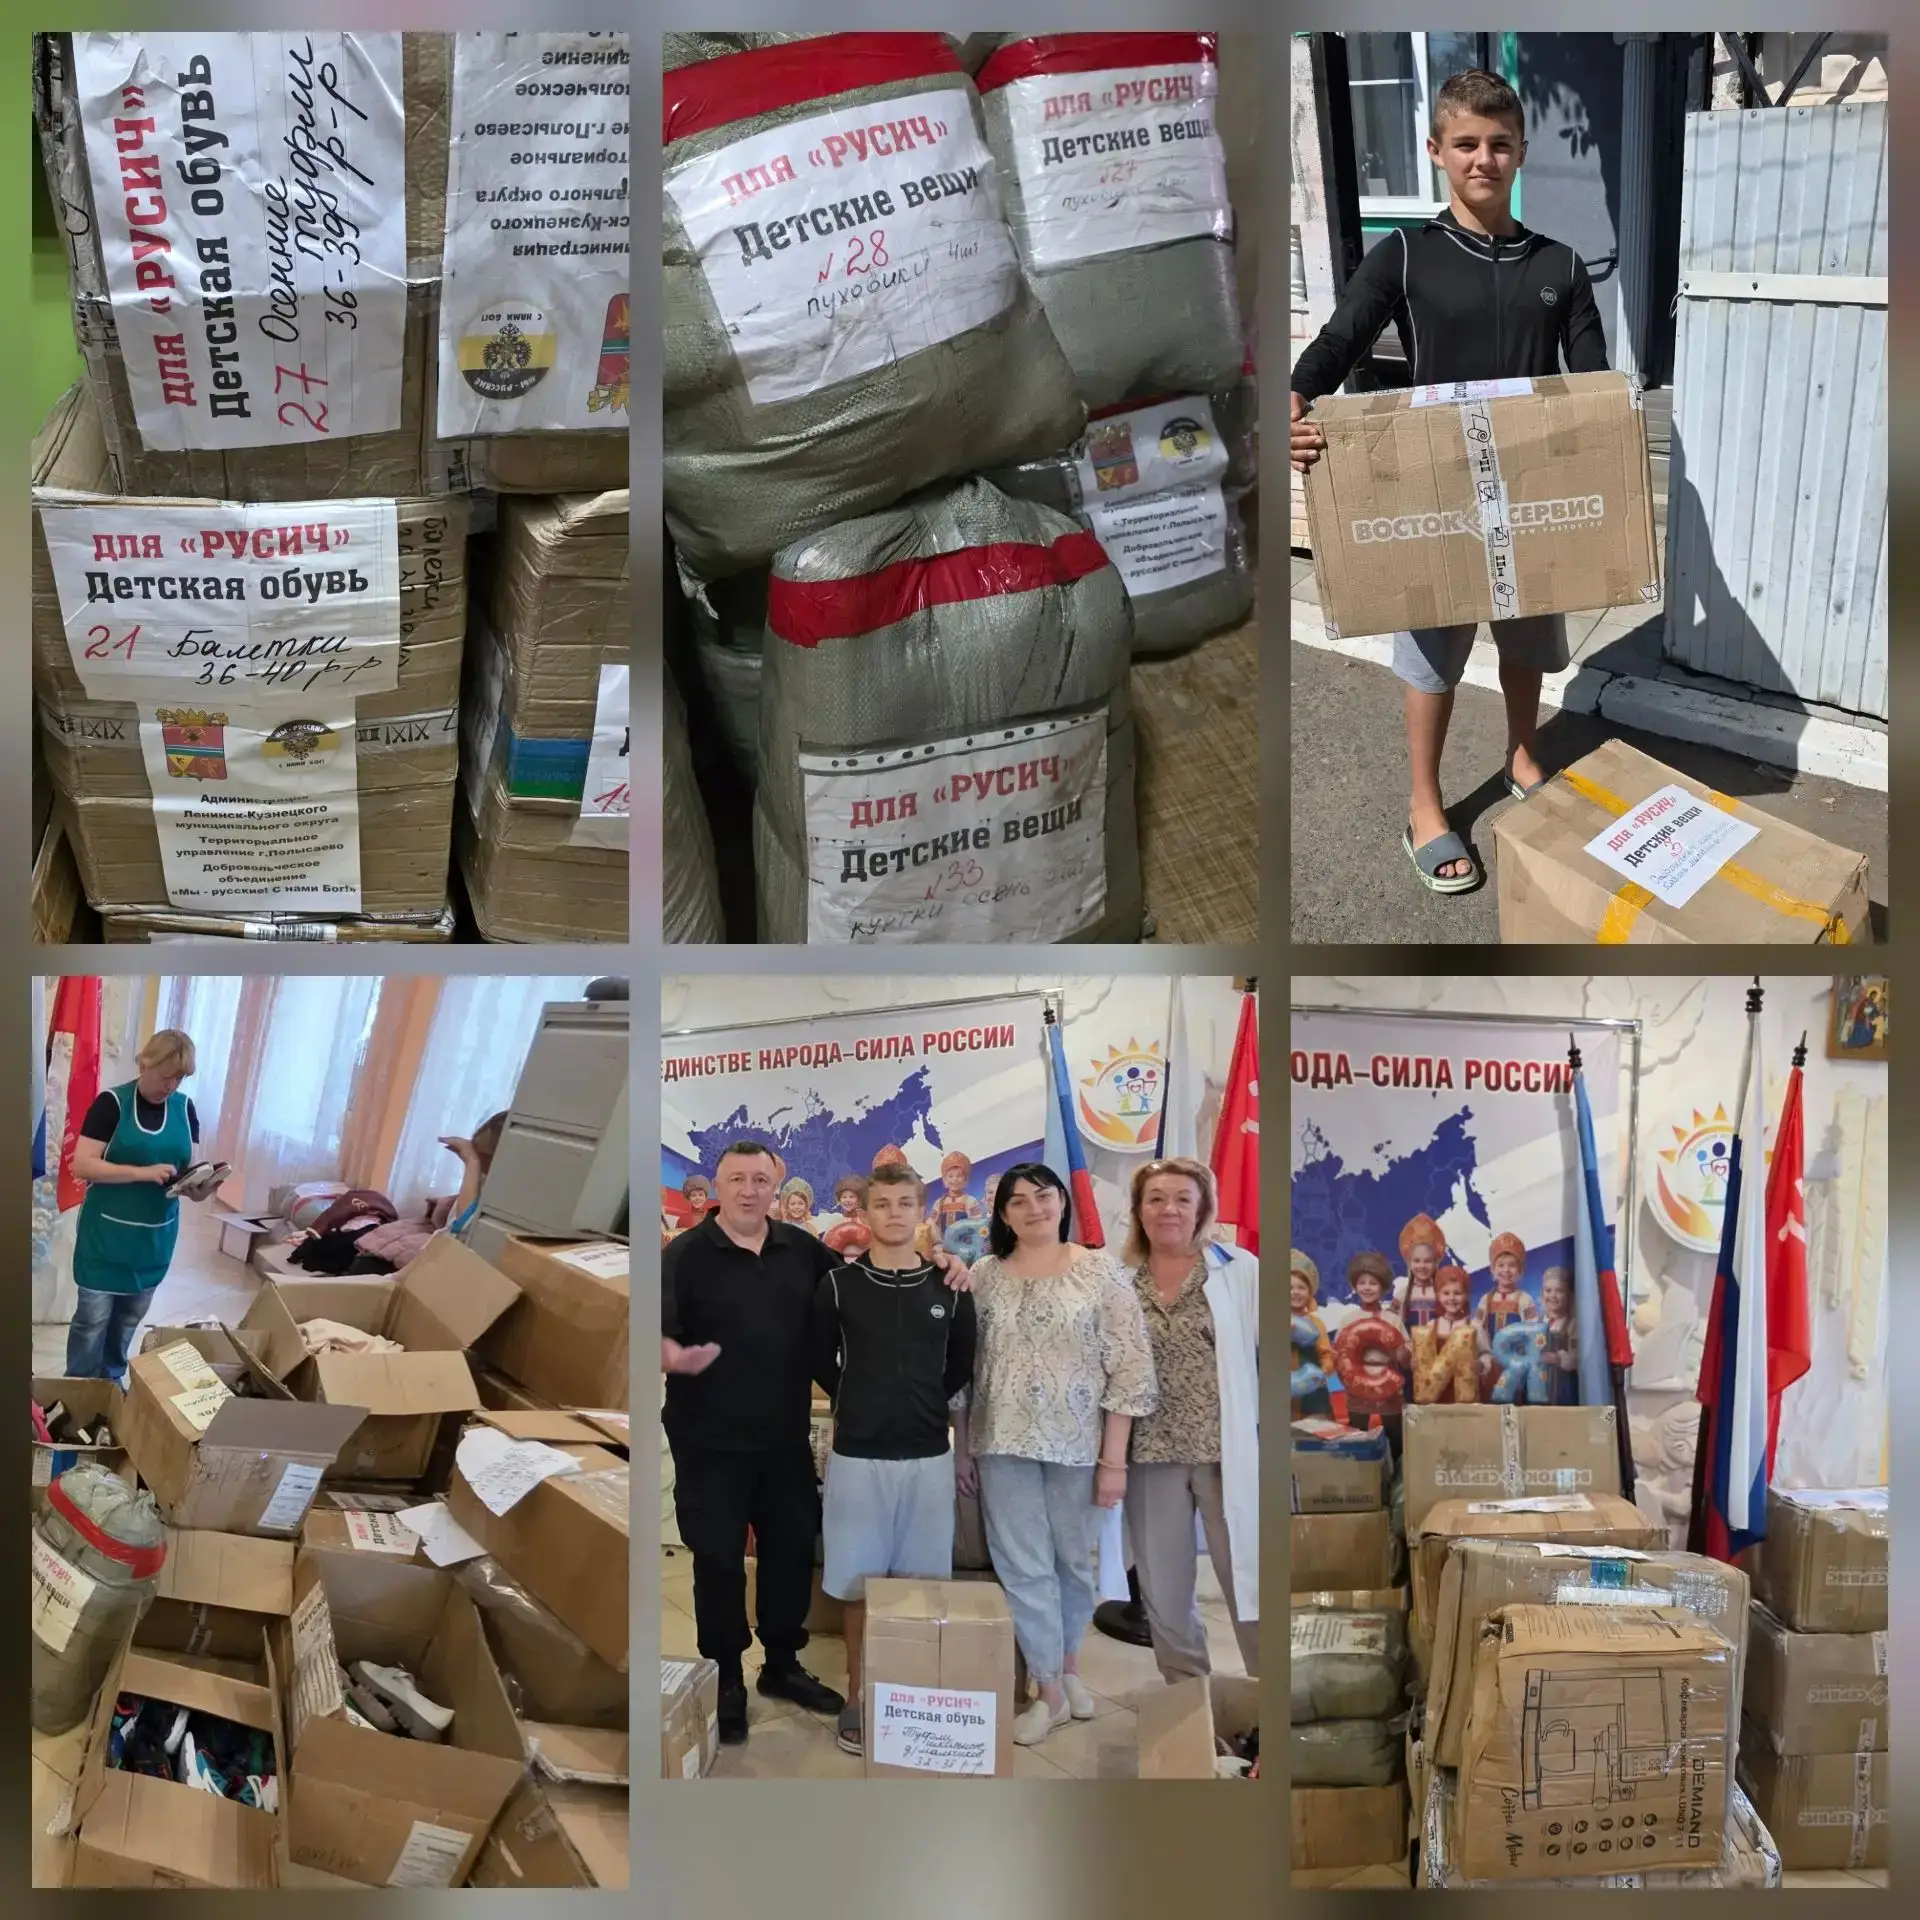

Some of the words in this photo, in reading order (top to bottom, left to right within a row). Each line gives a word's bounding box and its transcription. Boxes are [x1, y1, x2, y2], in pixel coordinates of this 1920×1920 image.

[1043, 92, 1092, 122] для
[1102, 75, 1195, 109] «РУСИЧ
[176, 54, 229, 216] обувь
[475, 122, 605, 139] г.Полысаево
[1041, 127, 1151, 166] Детские
[510, 149, 630, 164] ториальное
[721, 154, 798, 207] для
[808, 115, 949, 169] «РУСИЧ»
[113, 86, 176, 314] «РУСИЧ»
[476, 186, 543, 203] округа
[549, 186, 630, 201] ального
[733, 189, 896, 267] Детские
[900, 166, 979, 209] вещи
[512, 242, 630, 257] инистрация
[847, 230, 889, 276] 28
[196, 237, 251, 418] Детская
[154, 333, 197, 407] для
[274, 363, 330, 433] 27
[1354, 511, 1463, 542] ВОСТОК
[1508, 495, 1603, 526] СЕРВИС
[92, 533, 164, 562] для
[180, 522, 350, 560] «РУСИЧ»
[84, 571, 246, 603] Детская
[259, 567, 369, 604] обувь
[84, 624, 142, 660] 21
[850, 792, 918, 829] для
[933, 754, 1075, 804] «РУСИЧ»
[176, 820, 290, 831] муниципального
[293, 816, 339, 828] округа
[184, 804, 328, 820] Ленинск-Кузнецкого
[1606, 828, 1634, 852] для
[1632, 796, 1677, 830] «РУСИЧ»
[176, 848, 255, 859] управление
[199, 833, 319, 847] Территориальное
[840, 826, 991, 883] Детские
[1003, 800, 1082, 844] вещи
[1624, 824, 1677, 868] Детские
[1672, 806, 1703, 828] вещи
[202, 860, 321, 873] Добровольческое
[219, 873, 307, 884] объединение
[946, 859, 985, 891] 33
[661, 1051, 751, 1082] ДИНСТВЕ
[923, 1024, 1015, 1055] РОССИИ
[885, 1705, 942, 1723] Детская
[946, 1711, 986, 1727] обувь
[890, 1692, 915, 1704] для
[921, 1695, 980, 1708] «РУСИЧ»
[1501, 1787, 1520, 1827] Coffee
